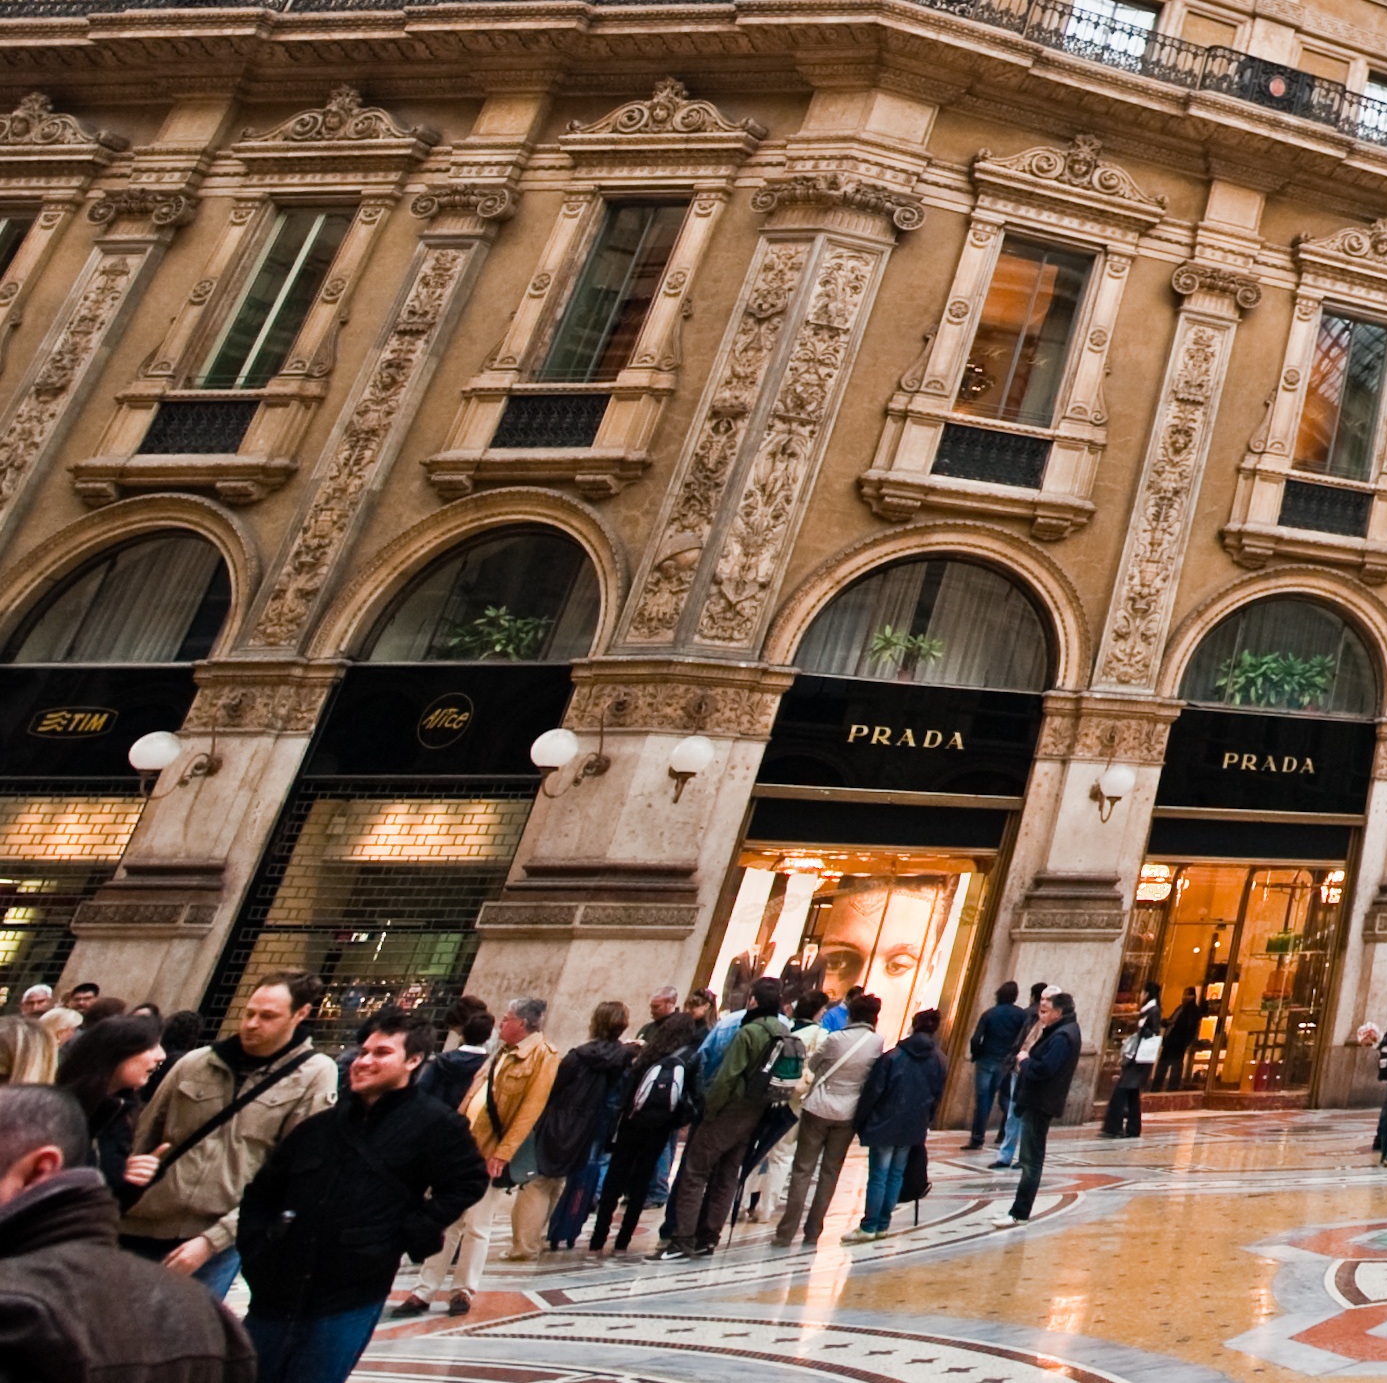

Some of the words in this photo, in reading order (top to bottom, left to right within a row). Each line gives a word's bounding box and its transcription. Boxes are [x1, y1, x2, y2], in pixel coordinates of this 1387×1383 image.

[67, 712, 109, 732] TIM
[846, 724, 966, 750] PRADA
[1222, 752, 1316, 774] PRADA
